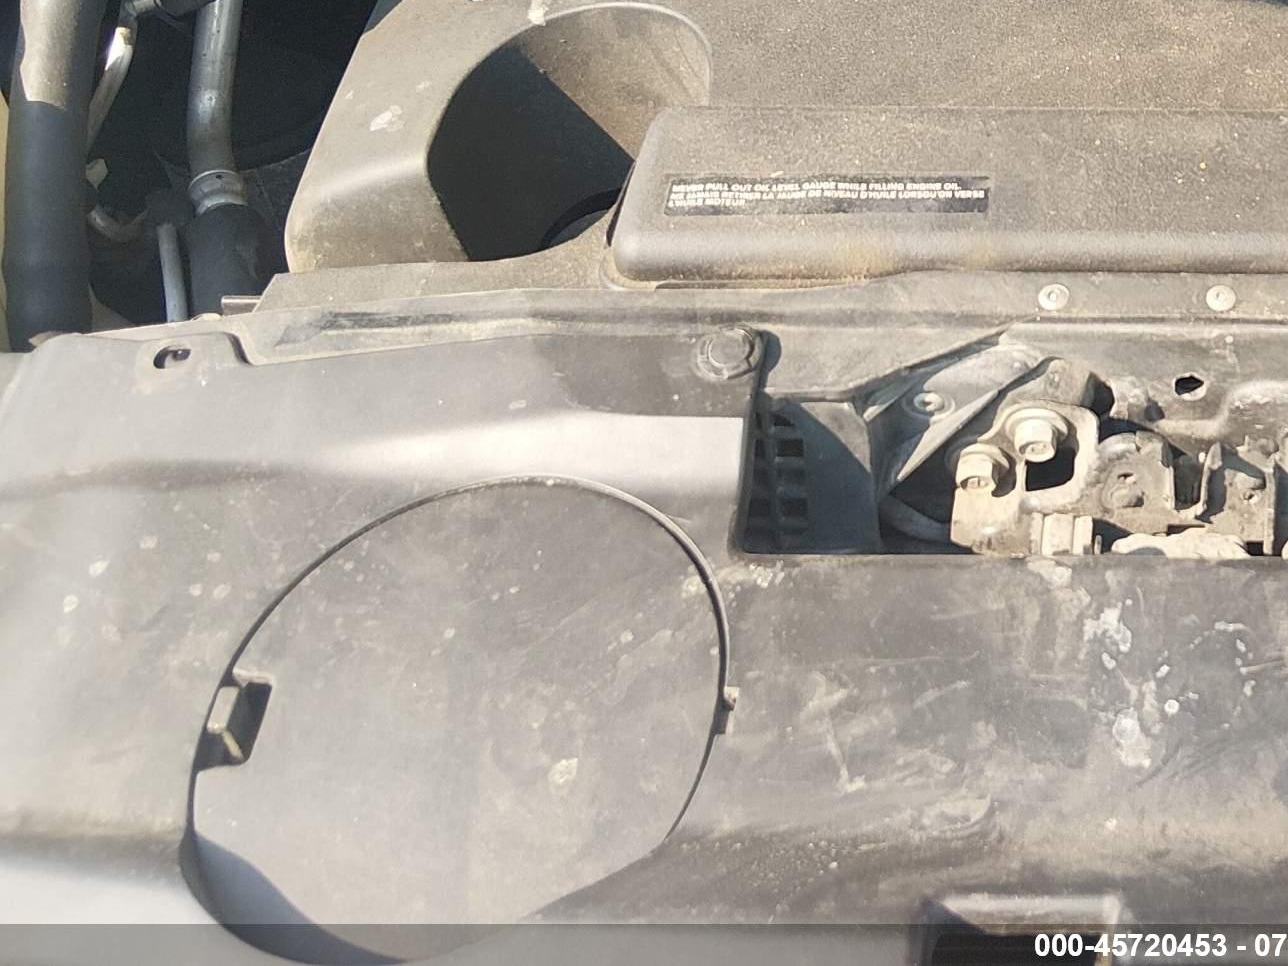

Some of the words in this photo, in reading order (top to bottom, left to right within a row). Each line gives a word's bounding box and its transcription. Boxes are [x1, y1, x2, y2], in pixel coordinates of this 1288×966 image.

[705, 183, 729, 191] PULL
[731, 184, 753, 192] OUT
[868, 182, 904, 191] FILLING
[943, 182, 962, 191] OIL.
[954, 190, 985, 199] VERSE
